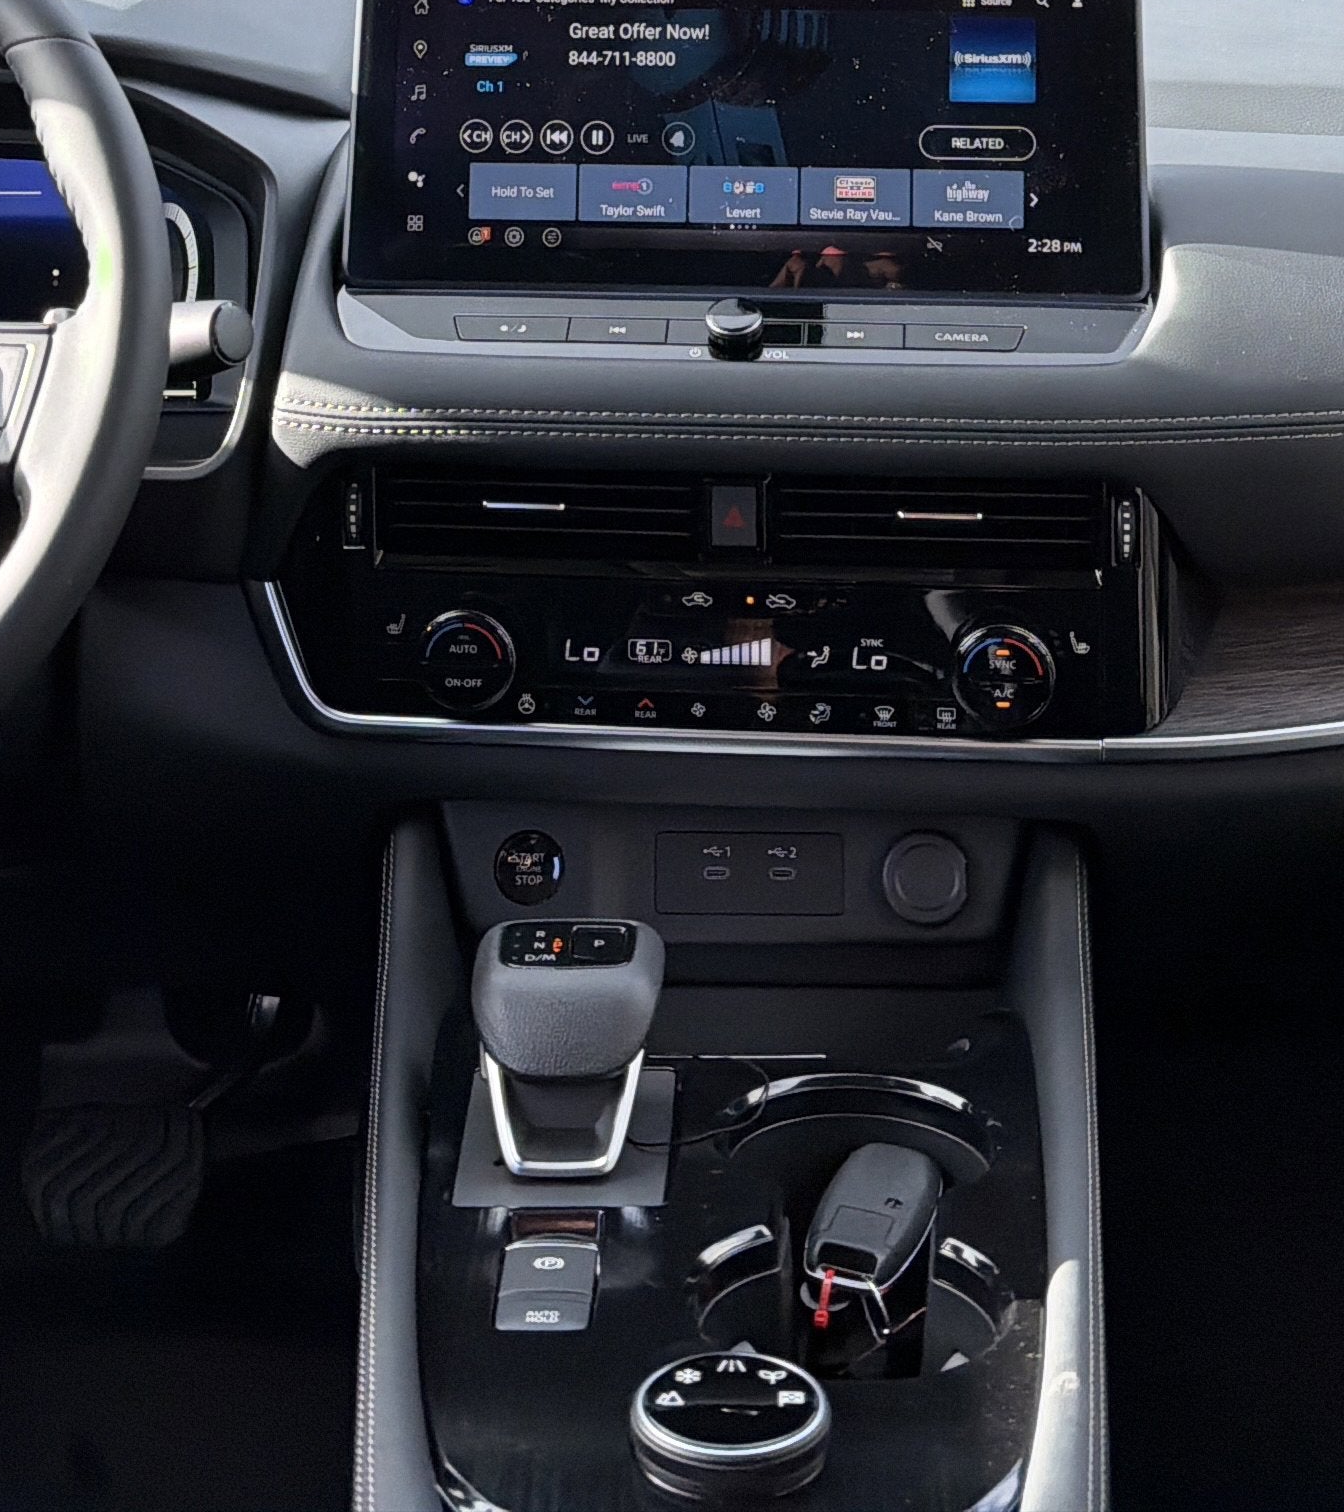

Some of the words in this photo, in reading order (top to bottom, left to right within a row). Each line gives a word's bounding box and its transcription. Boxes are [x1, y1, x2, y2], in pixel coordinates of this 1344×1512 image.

[569, 22, 615, 40] Great
[619, 22, 663, 40] Offer
[666, 23, 710, 41] Now!
[568, 50, 676, 67] 844-711-8800
[476, 80, 494, 93] Ch
[497, 80, 504, 93] 1
[627, 134, 649, 144] LIVE
[951, 137, 1004, 150] RELATED
[491, 186, 517, 198] Hold
[520, 186, 534, 198] To
[536, 186, 554, 198] Set
[600, 204, 635, 218] Taylor
[636, 204, 665, 217] Swift
[726, 207, 761, 219] Levert
[809, 208, 844, 221] Stevie
[846, 208, 868, 223] Ray
[934, 210, 963, 222] Kane
[966, 210, 1003, 223] Brown
[1027, 238, 1061, 254] 2:28
[1063, 240, 1082, 254] PM
[934, 332, 989, 343] CAMERA
[763, 350, 789, 360] VOL
[860, 638, 885, 648] SYNC
[449, 644, 478, 655] AUTO
[565, 638, 600, 662] Lo
[637, 654, 663, 664] REAR
[852, 646, 888, 670] Lo
[989, 659, 1017, 670] SYNC
[993, 689, 1015, 699] A/C
[574, 707, 597, 717] REAR
[634, 710, 657, 719] REAR
[873, 720, 898, 728] FRONT
[937, 722, 957, 730] REAR
[725, 846, 731, 857] 1
[789, 847, 798, 858] 2
[513, 852, 545, 863] START
[515, 875, 543, 886] STOP
[533, 942, 546, 950] N
[593, 940, 605, 949] P
[524, 953, 557, 962] D/M
